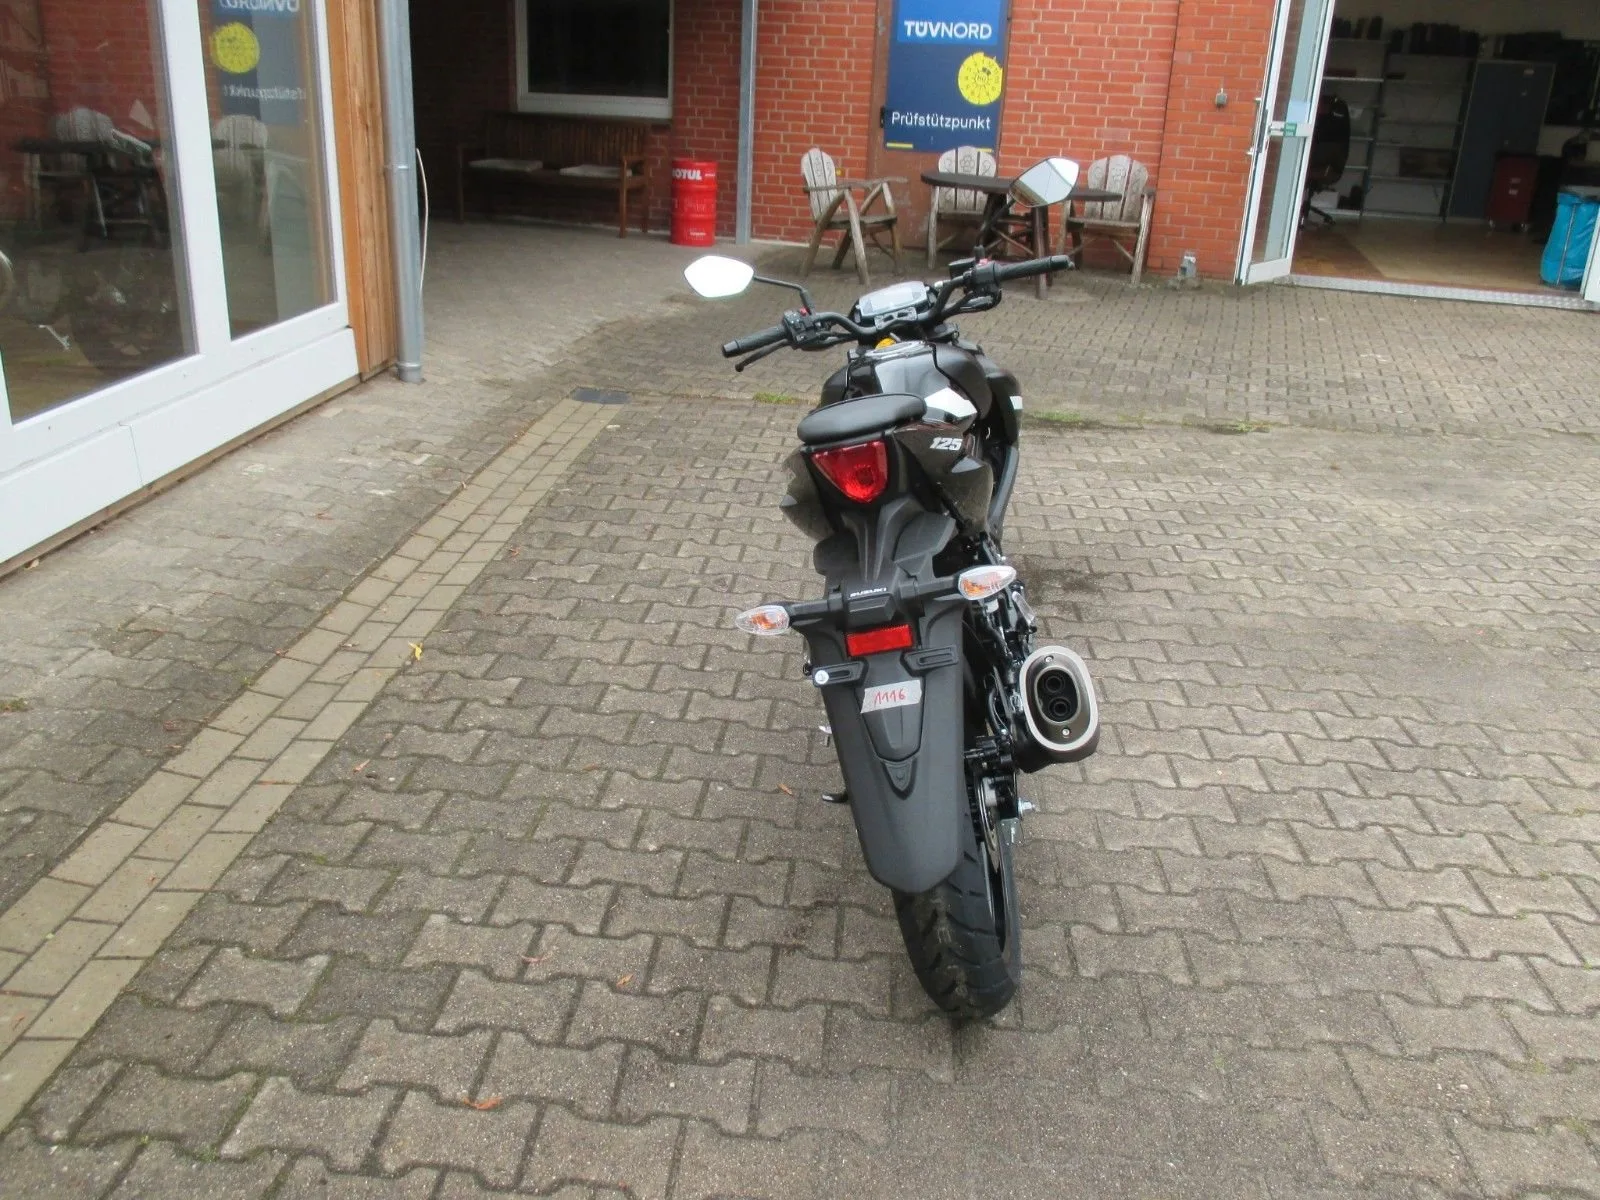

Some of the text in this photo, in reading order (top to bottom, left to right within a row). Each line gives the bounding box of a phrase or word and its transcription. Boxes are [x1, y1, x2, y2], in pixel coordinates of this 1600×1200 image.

[904, 20, 992, 39] TÜVNORD
[891, 111, 991, 131] Prüfstützpunkt
[930, 437, 963, 450] 125
